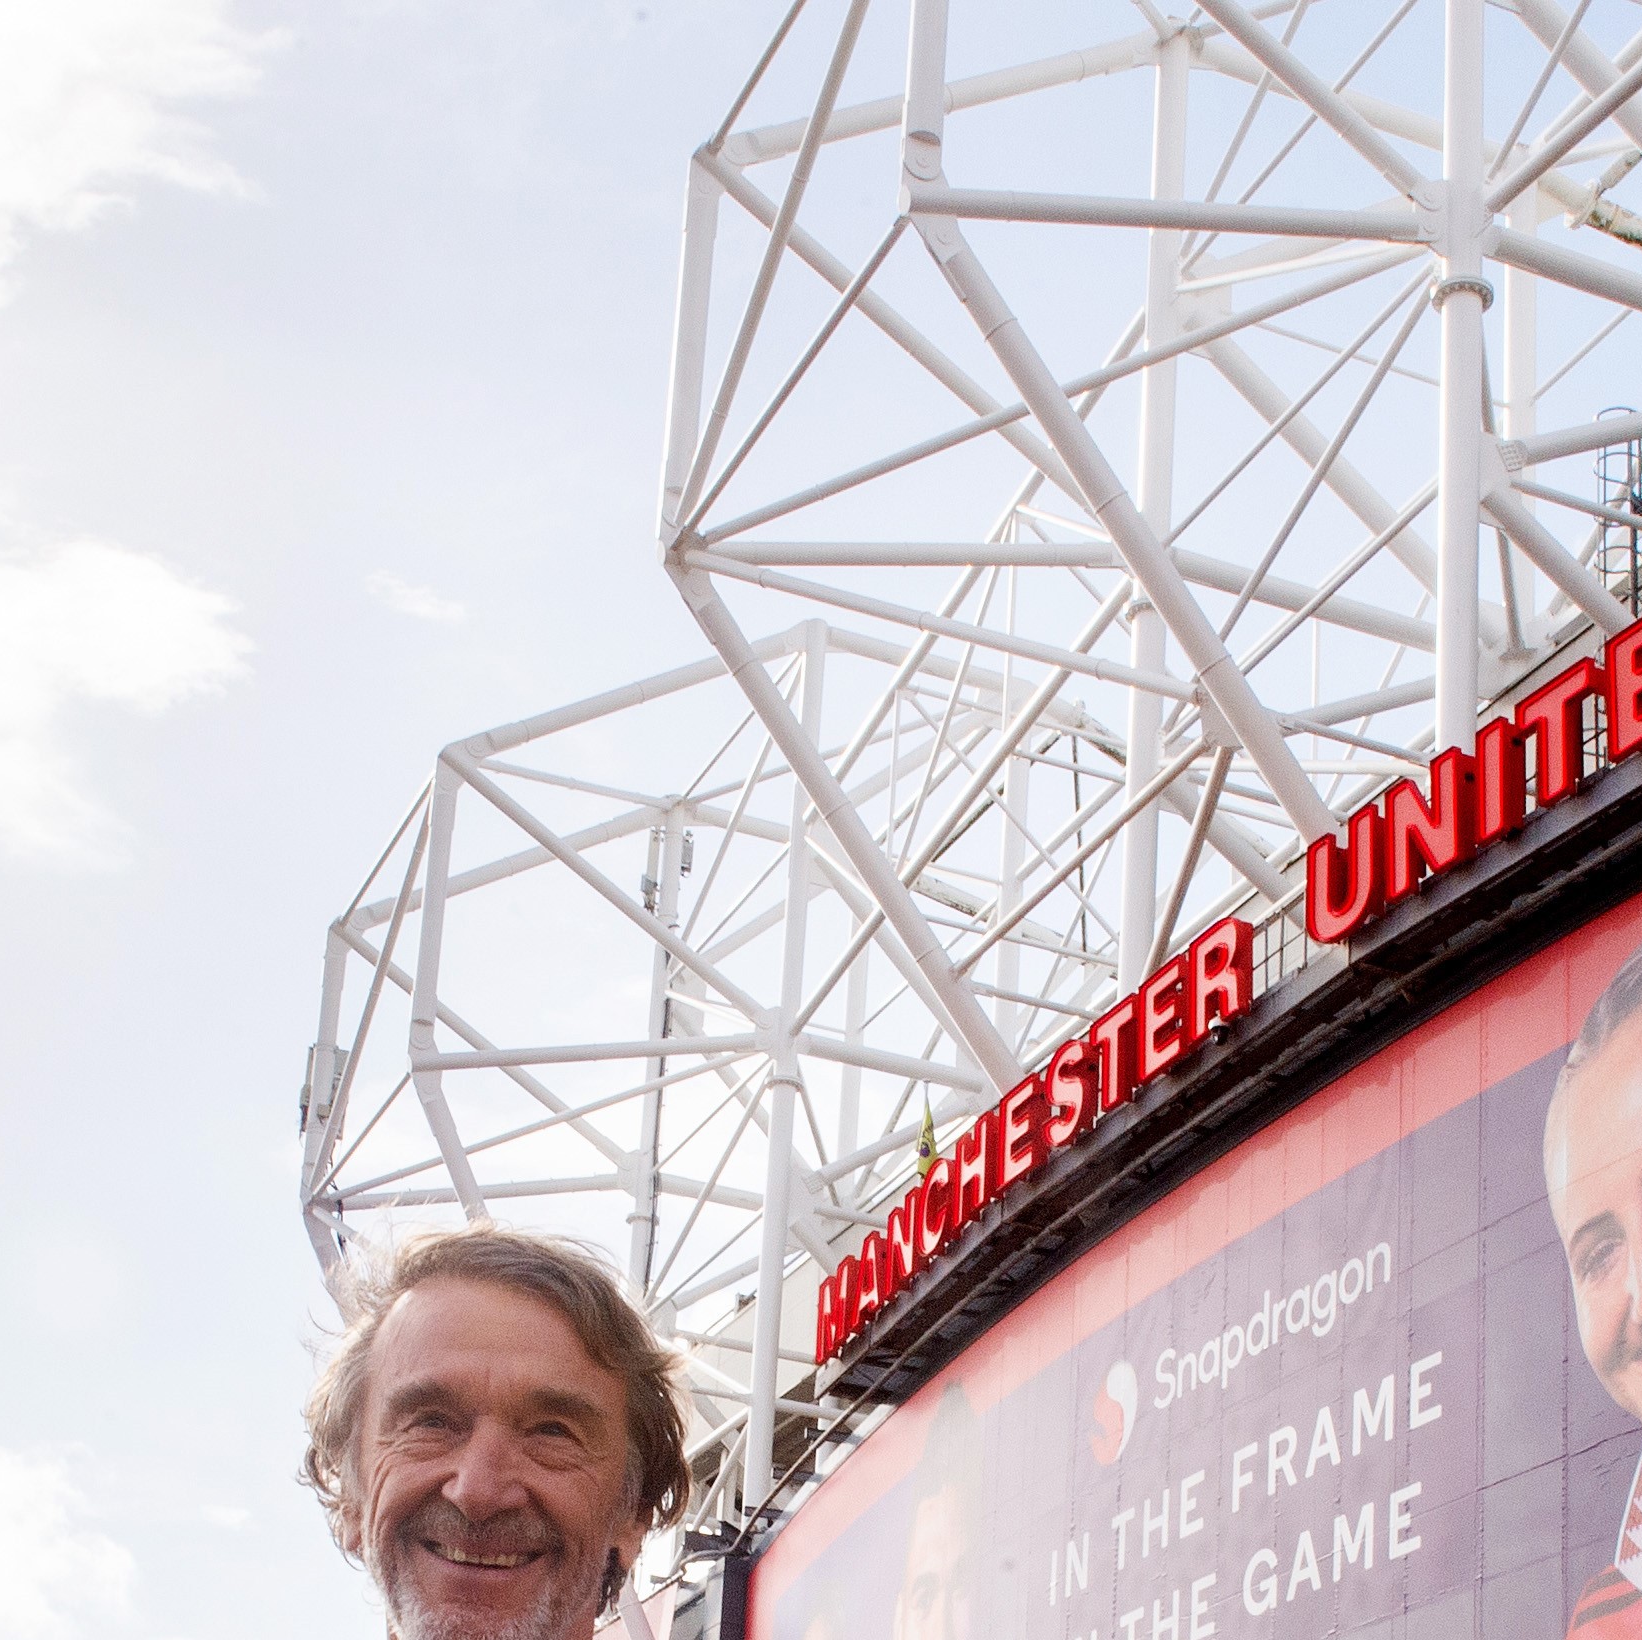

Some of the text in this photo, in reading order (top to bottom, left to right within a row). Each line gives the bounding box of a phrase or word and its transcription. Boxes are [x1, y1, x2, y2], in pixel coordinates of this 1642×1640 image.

[815, 917, 1253, 1365] MANCHESTER
[1153, 1241, 1391, 1409] Snapdragon
[1049, 1351, 1443, 1607] IN THE FRAME
[1242, 1481, 1422, 1617] GAME
